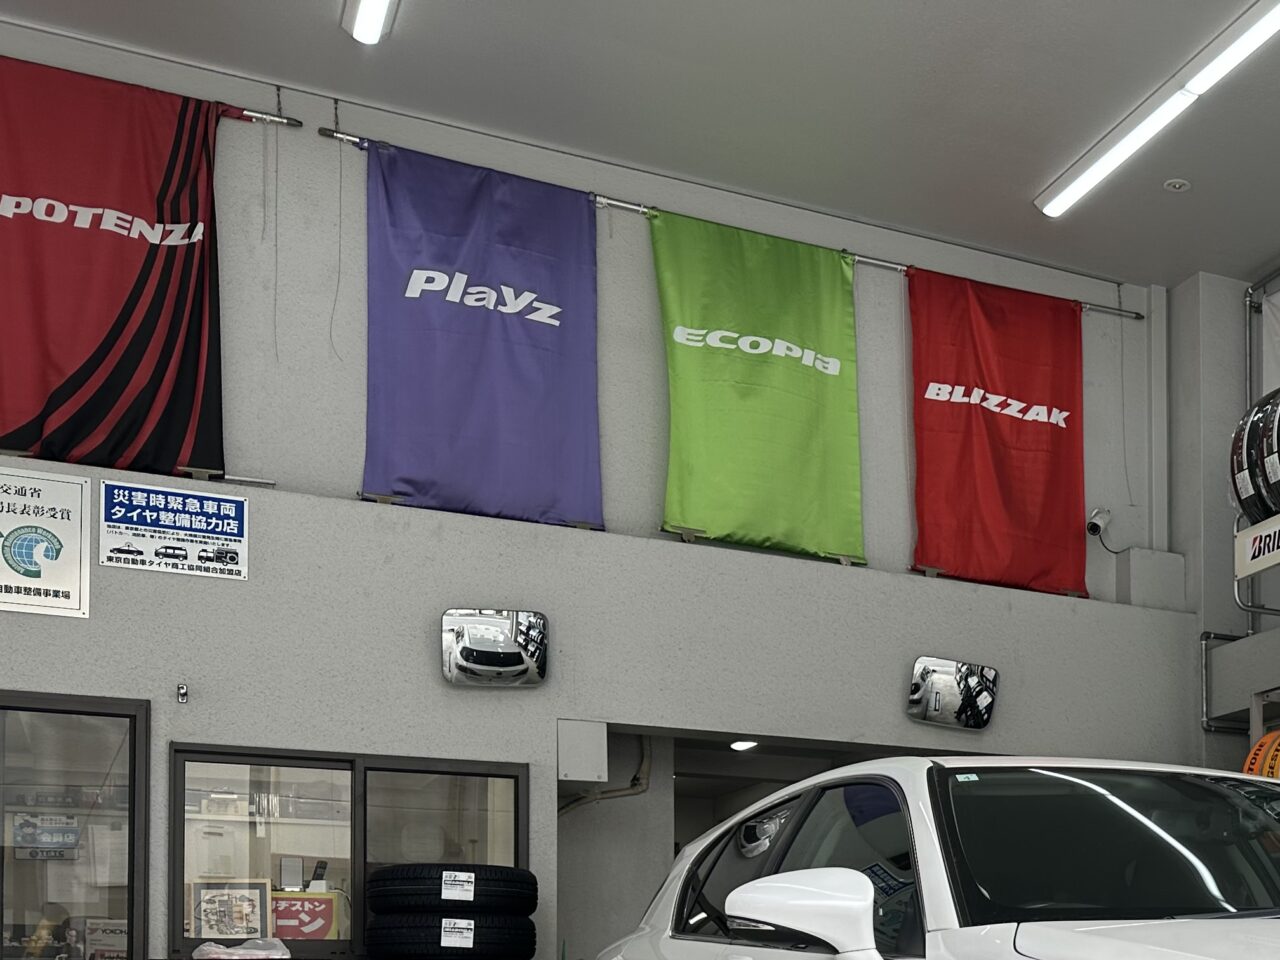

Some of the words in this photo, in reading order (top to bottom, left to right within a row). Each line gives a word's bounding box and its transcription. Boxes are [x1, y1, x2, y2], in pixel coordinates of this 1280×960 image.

[404, 268, 563, 327] Playz
[924, 382, 1070, 428] BLIZZAK
[111, 506, 238, 534] タイヤ整備協力店
[113, 488, 236, 517] 災害時緊急車両
